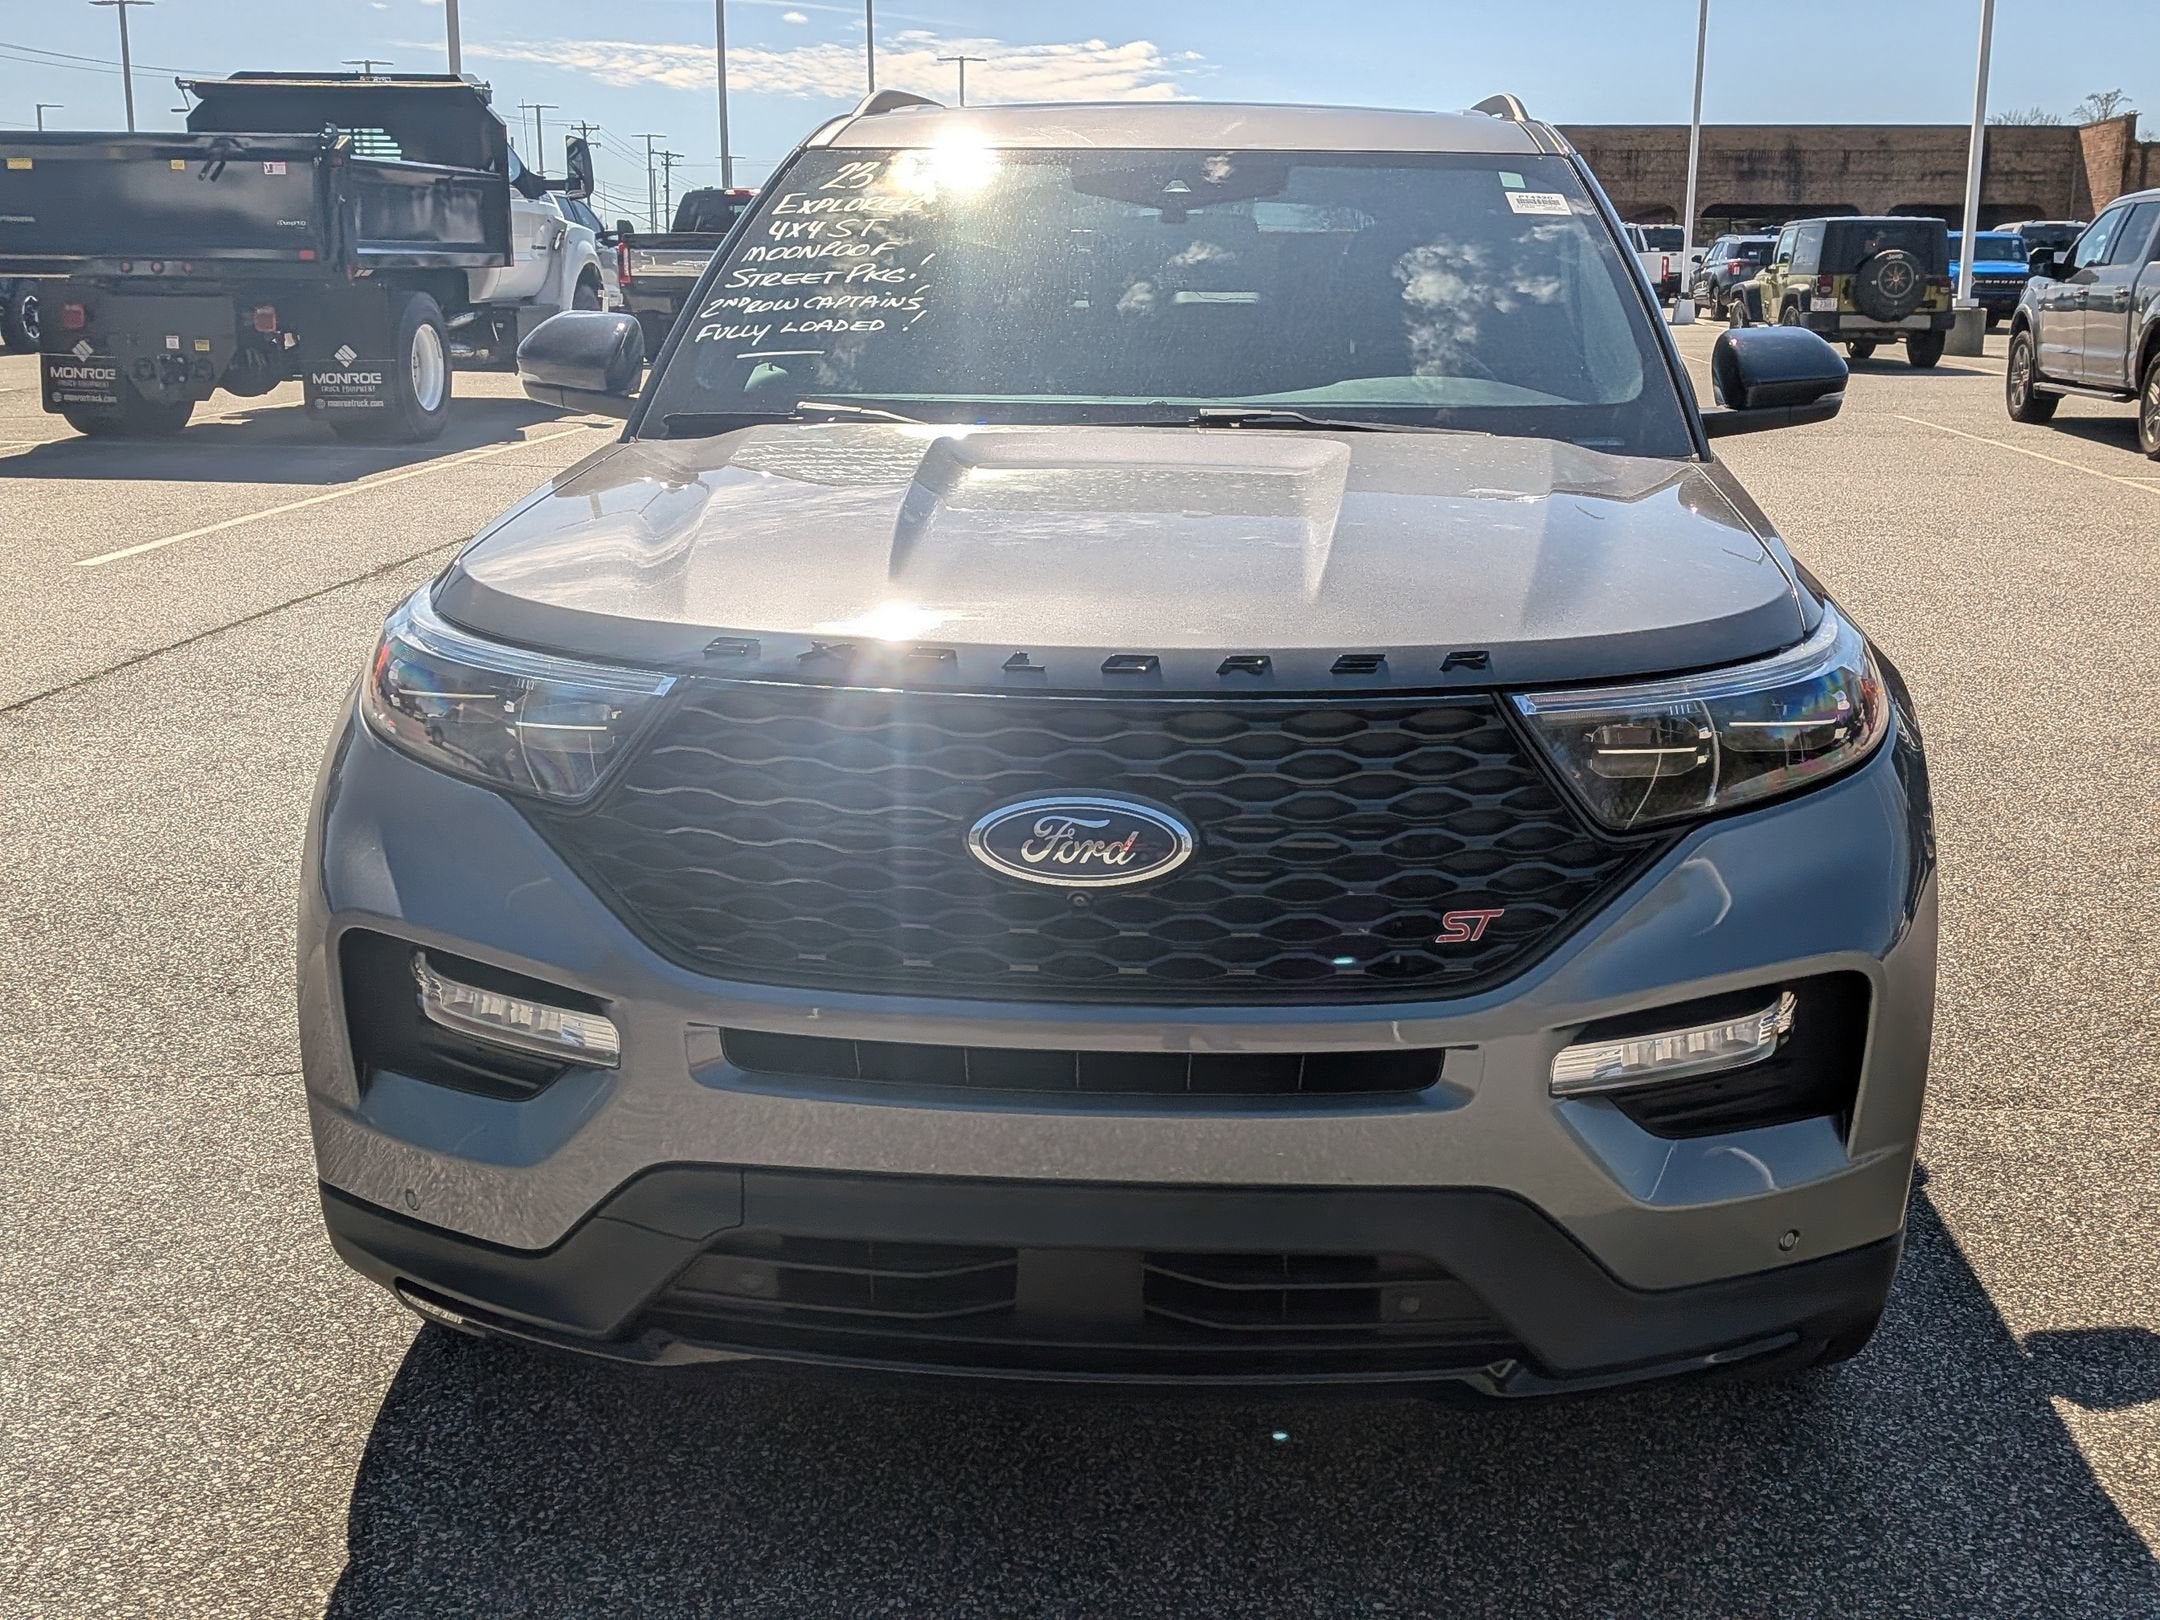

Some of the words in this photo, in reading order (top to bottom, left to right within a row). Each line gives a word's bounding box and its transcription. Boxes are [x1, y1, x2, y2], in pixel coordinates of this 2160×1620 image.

[819, 161, 881, 190] 23
[772, 192, 924, 215] EXPLORER
[828, 219, 890, 238] ST
[741, 241, 901, 262] MOONROOF
[725, 267, 847, 289] STREET
[743, 297, 800, 314] ROW
[695, 323, 772, 346] FULLY
[780, 319, 885, 333] LOADED
[49, 366, 117, 380] MONROE
[312, 372, 382, 385] MONROE
[321, 385, 341, 393] TRUCK
[342, 385, 376, 393] EQUIPMENT
[1020, 815, 1136, 866] Ford
[1435, 908, 1504, 944] ST
